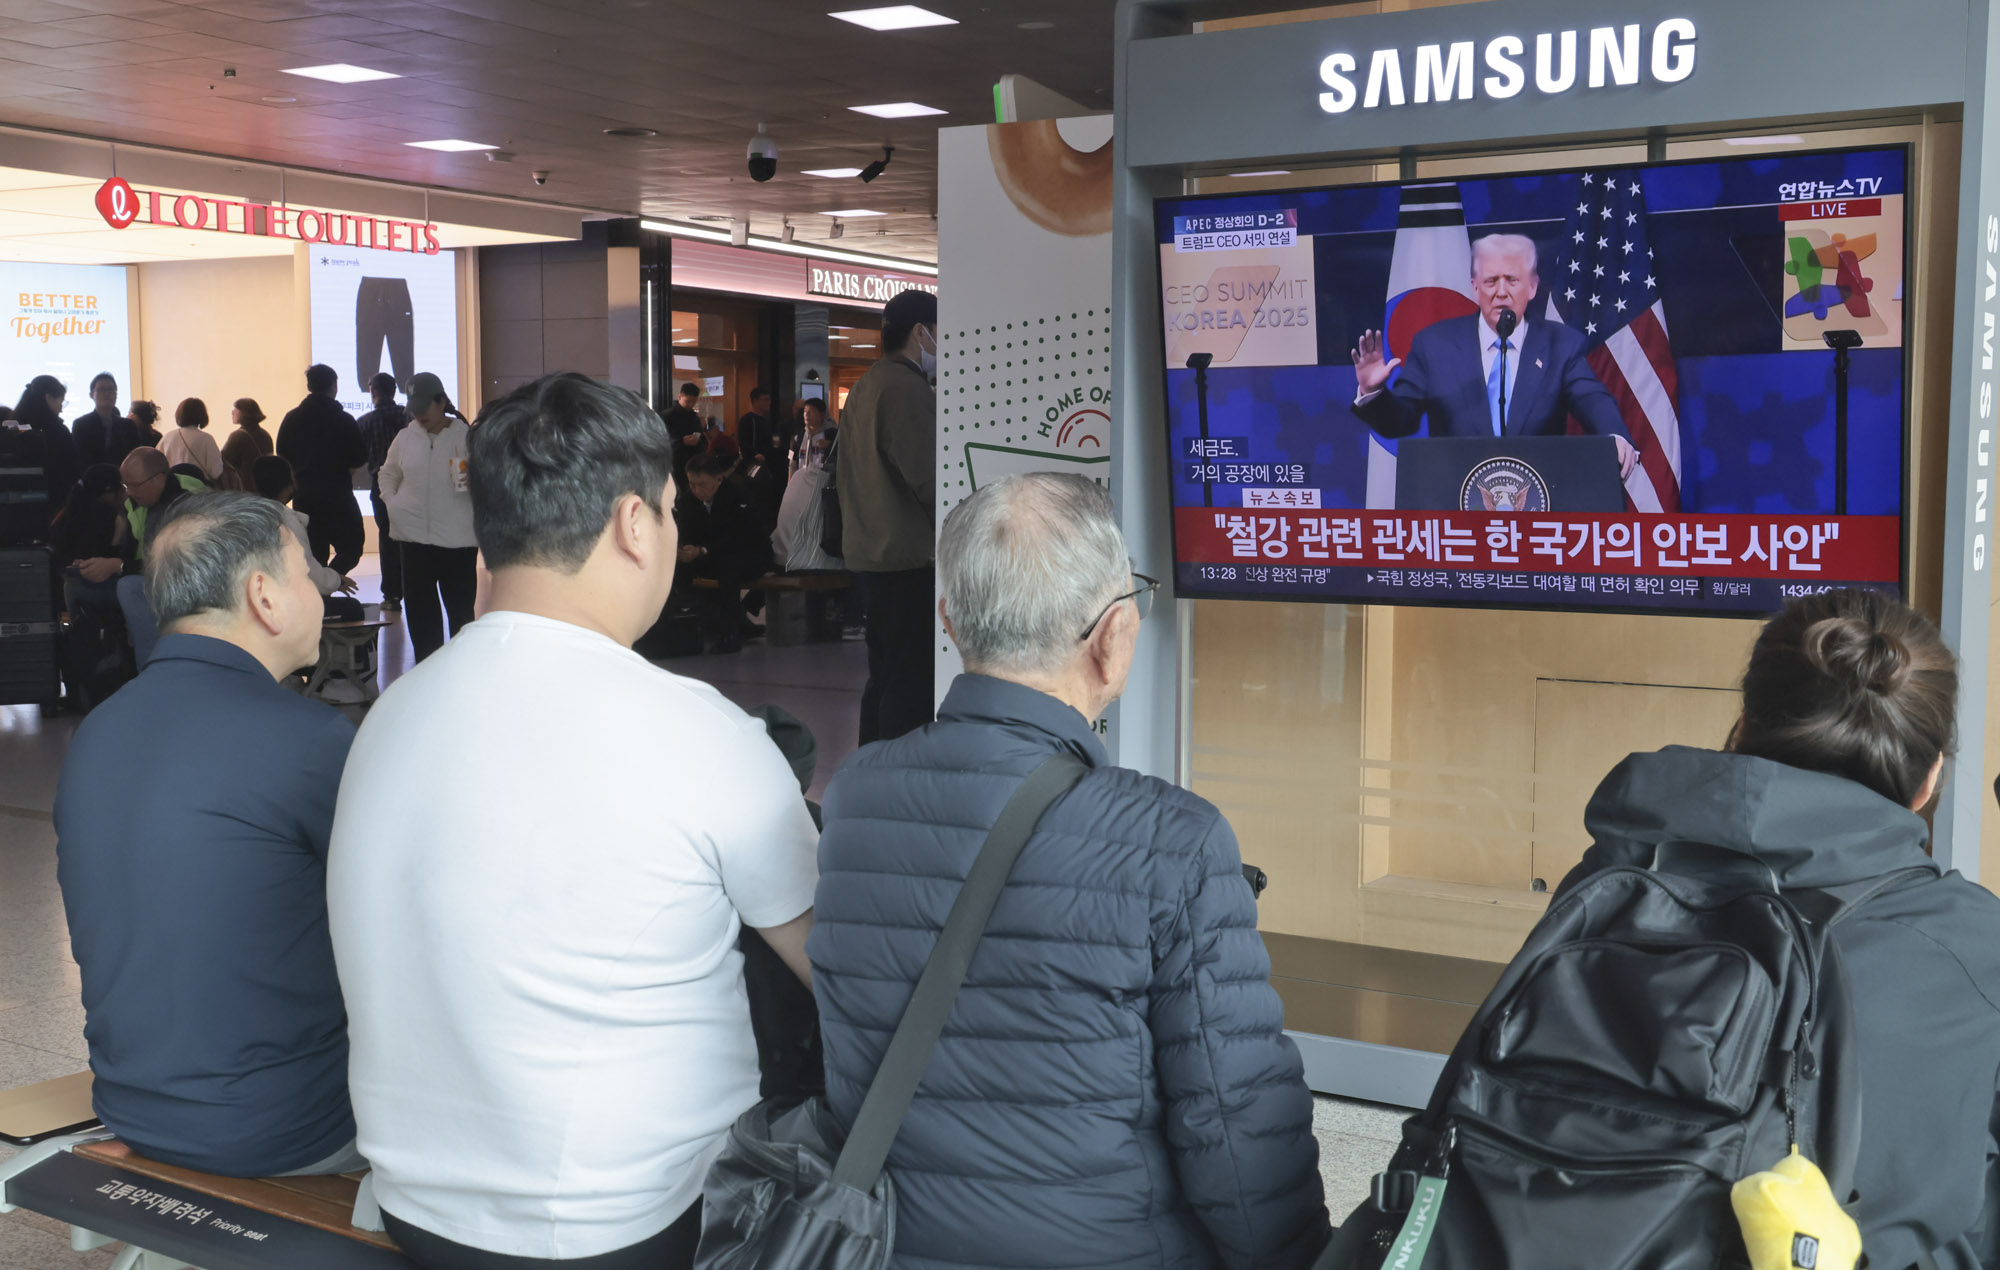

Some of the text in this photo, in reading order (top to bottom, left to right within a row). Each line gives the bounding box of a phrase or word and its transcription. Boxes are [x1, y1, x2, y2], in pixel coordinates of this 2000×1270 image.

[1319, 18, 1697, 114] SAMSUNG
[1778, 177, 1882, 201] 연합뉴스TV
[1185, 213, 1284, 231] APEC 정상회의 D-2
[1811, 203, 1847, 217] LIVE
[150, 191, 290, 238] LOTTE
[297, 209, 440, 256] OUTLETS
[1182, 231, 1291, 250] 트럼프 CEO 서밋 연설
[812, 268, 860, 298] PARIS
[1165, 279, 1308, 304] CEO SUMMIT
[18, 293, 98, 309] BETTER
[10, 315, 106, 343] Together
[1168, 307, 1309, 332] KOREA 2025
[1973, 214, 1998, 572] SAMSUNG
[1037, 387, 1084, 438] HOME
[1189, 439, 1239, 457] 세금도.
[1191, 464, 1306, 483] 거의 공장에 있을
[1250, 490, 1315, 507] 뉴스속보
[1214, 513, 1840, 572] "철강 관련 관세는 한 국가의 안보 사안"
[1200, 566, 1237, 580] 13:28
[1245, 566, 1331, 584] 진상 완전 규명"
[1376, 570, 1404, 586] 국힘
[1407, 571, 1453, 589] 정성국,
[1533, 574, 1577, 592] 대여할
[1581, 576, 1596, 593] 때
[1600, 576, 1630, 594] 면허
[1634, 577, 1665, 595] 확인
[1669, 578, 1700, 596] 의무
[1712, 582, 1751, 596] 원/달러
[96, 1179, 269, 1242] 교통약자배려석 Priority seat
